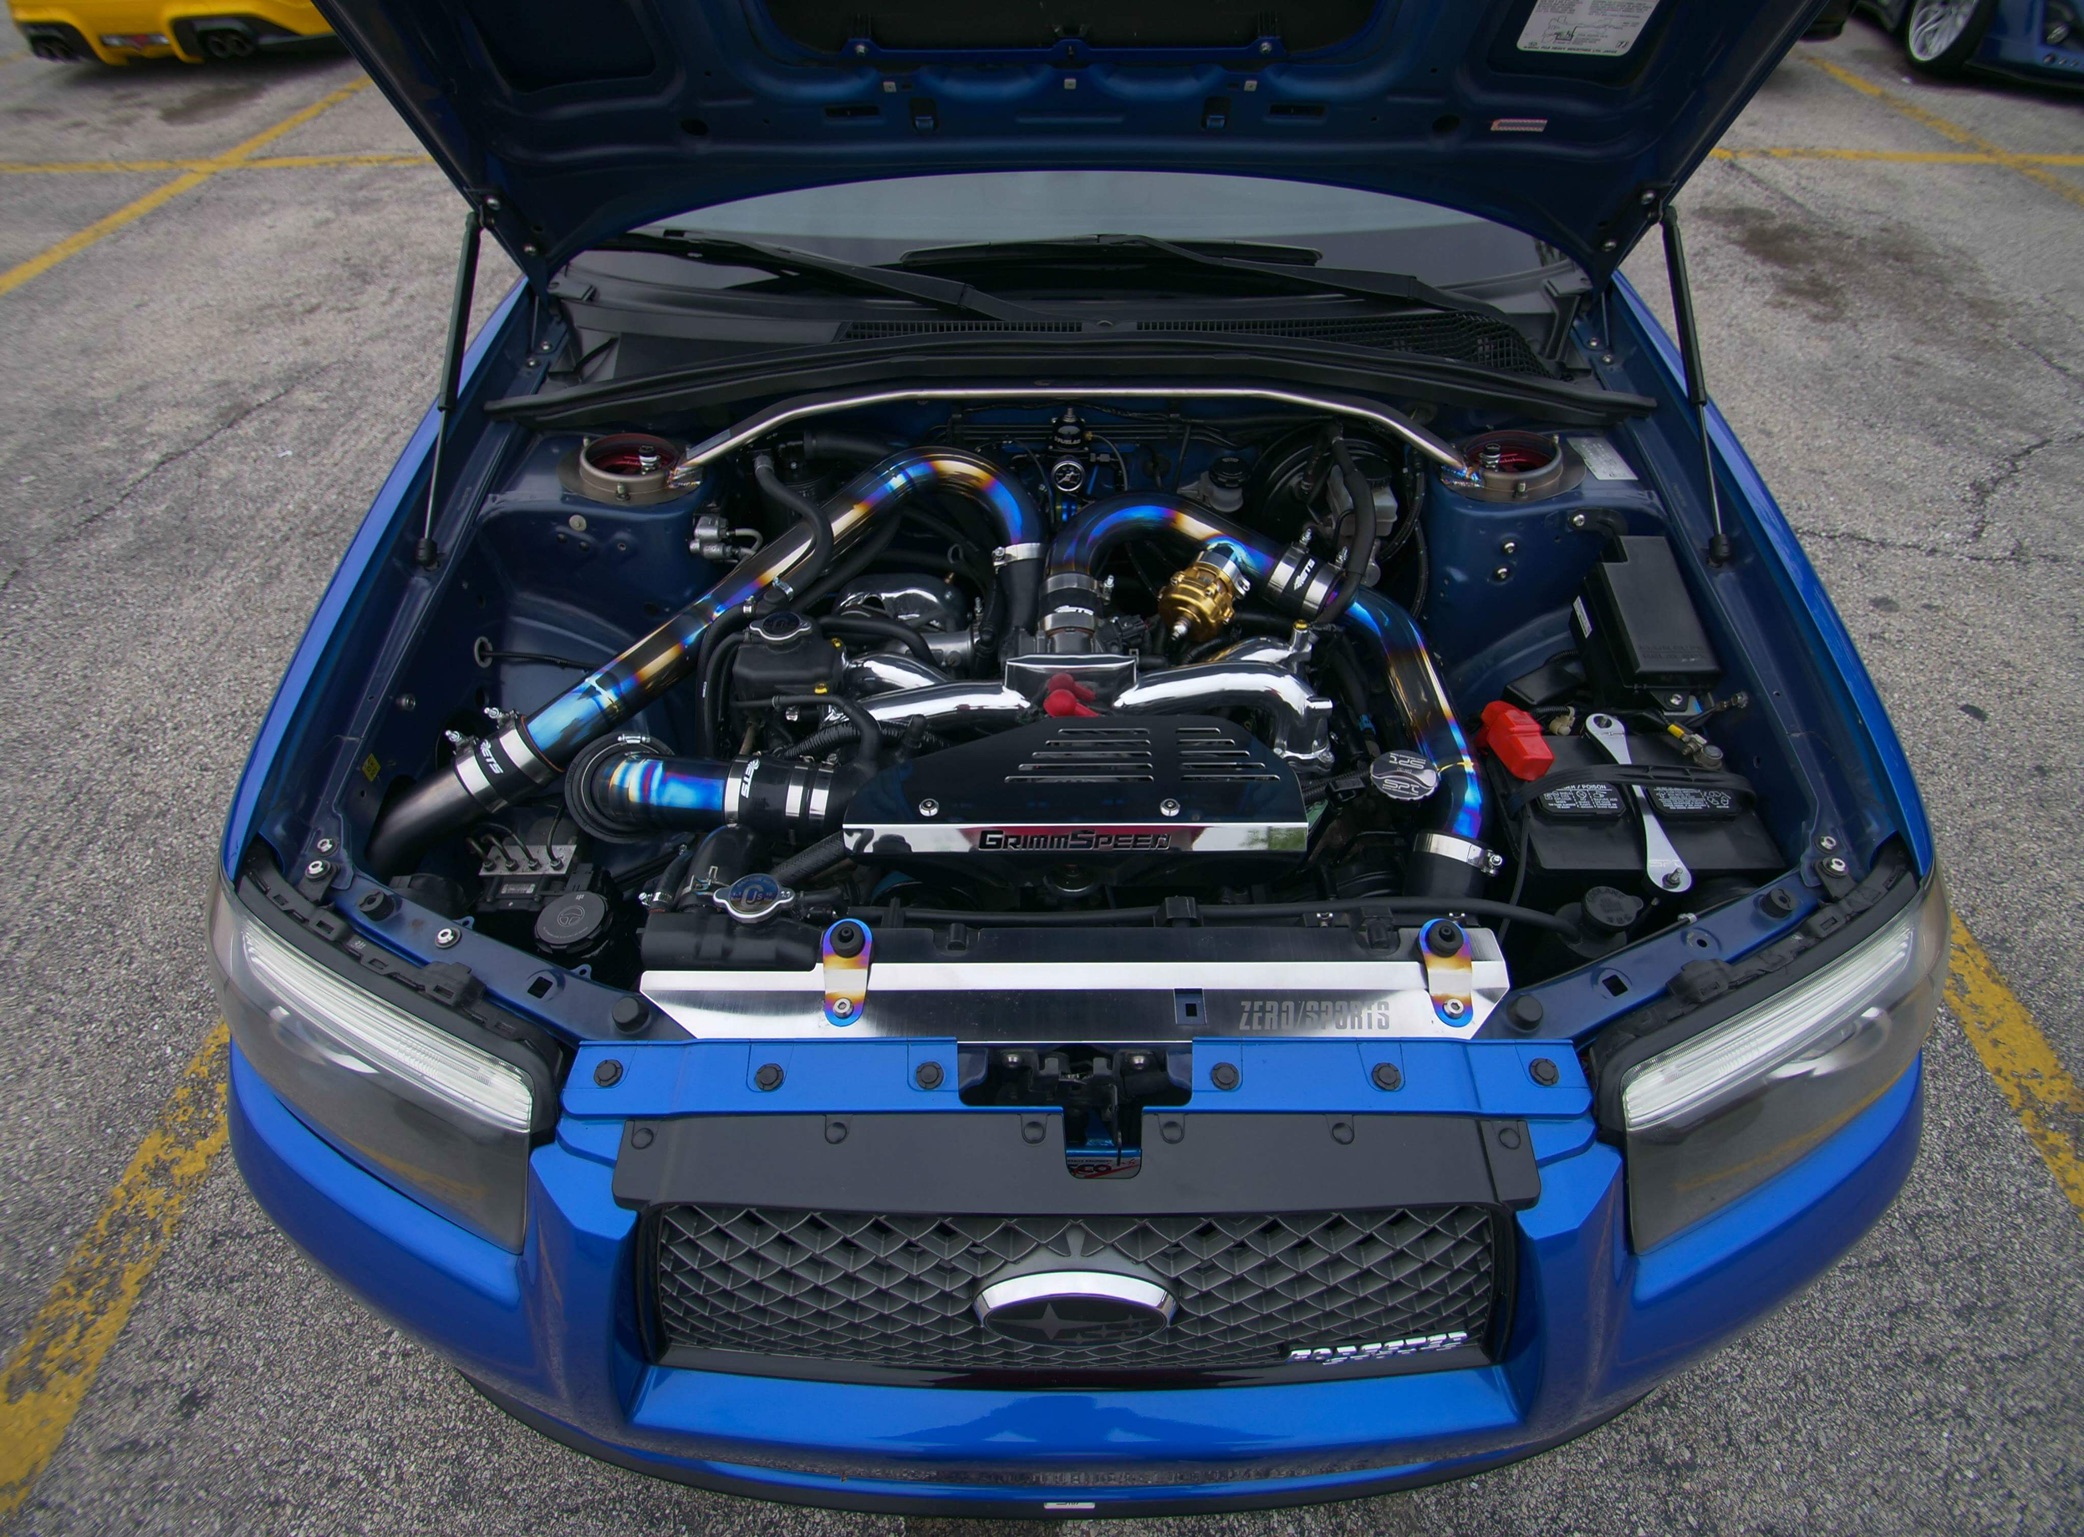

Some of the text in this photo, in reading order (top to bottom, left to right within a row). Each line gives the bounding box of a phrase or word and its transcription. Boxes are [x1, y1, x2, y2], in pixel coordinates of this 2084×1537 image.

[481, 745, 504, 774] ETS
[1389, 755, 1426, 770] SPT
[741, 764, 757, 799] ETS
[1383, 778, 1420, 793] SPT
[1239, 1000, 1390, 1030] ZERO/SPORTS
